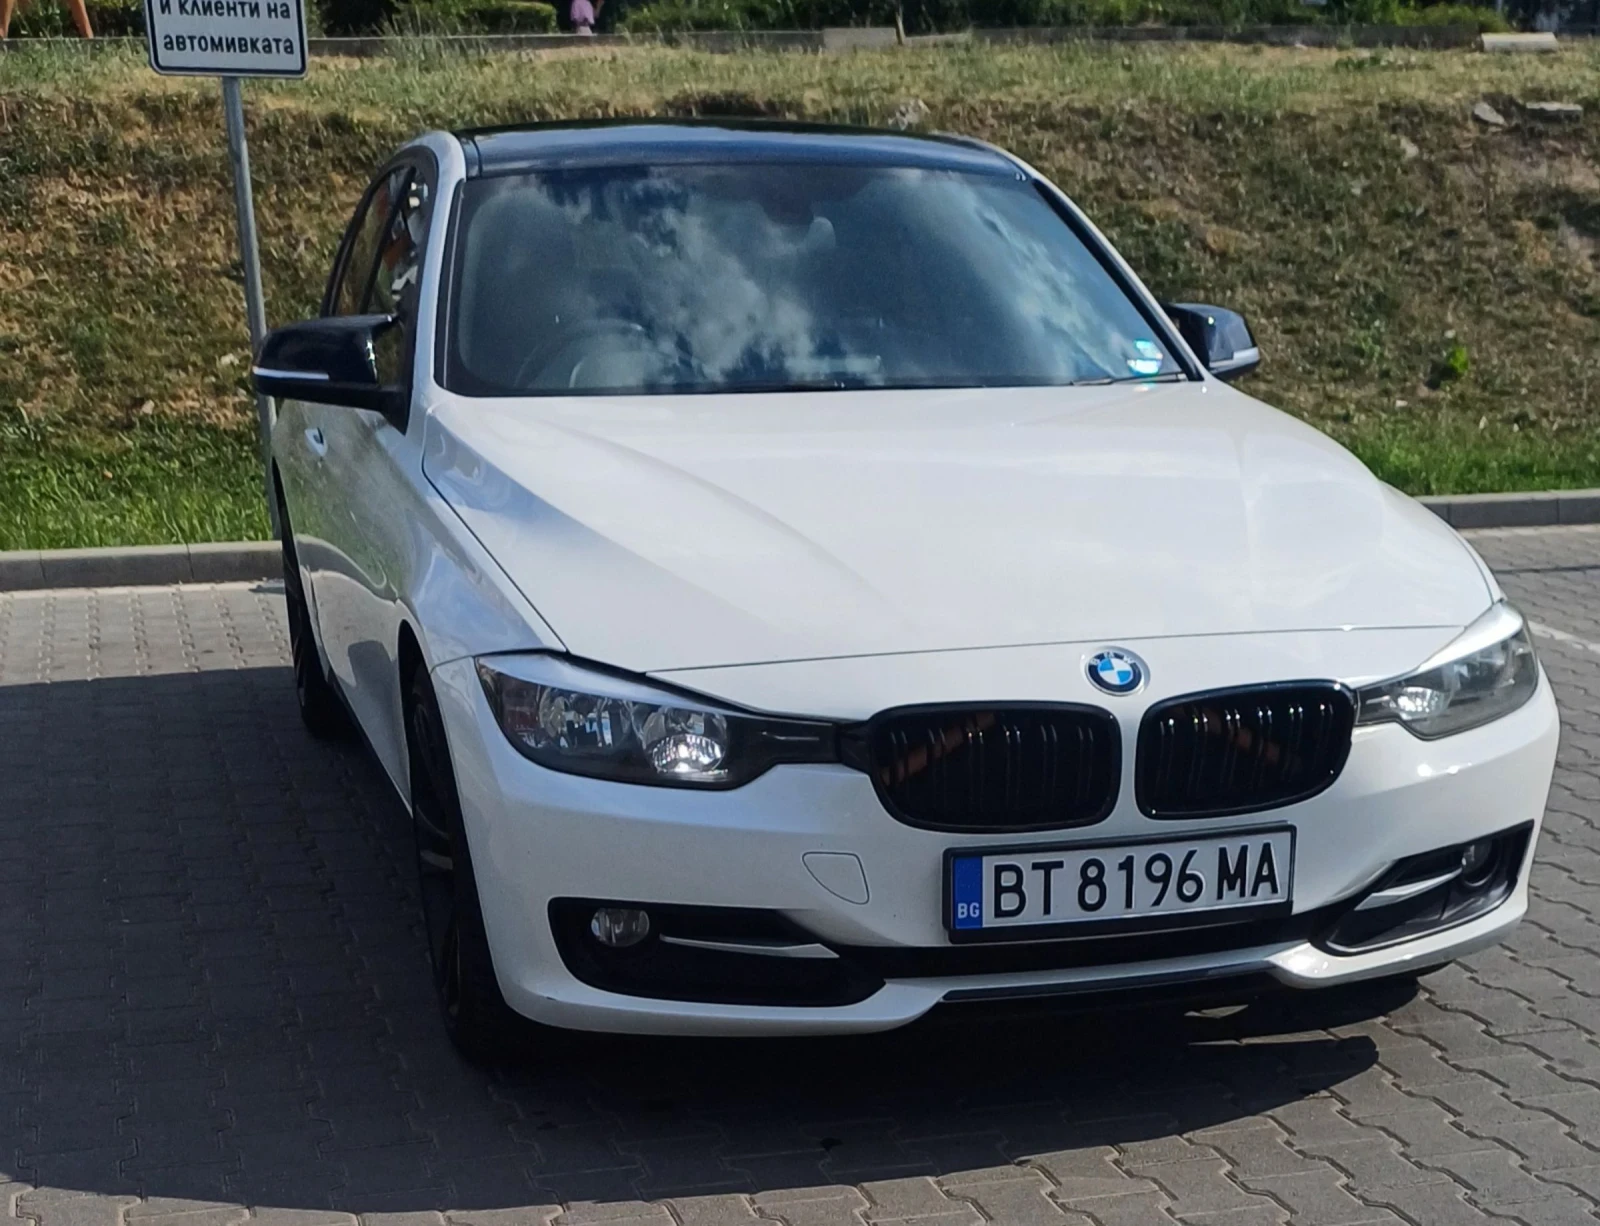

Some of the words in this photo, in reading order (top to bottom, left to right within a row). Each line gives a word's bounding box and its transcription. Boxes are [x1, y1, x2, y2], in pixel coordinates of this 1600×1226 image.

[159, 0, 171, 15] и
[178, 0, 260, 19] клиенти
[267, 2, 291, 19] на
[163, 34, 294, 55] автомивката
[993, 860, 1064, 919] BT
[1077, 849, 1204, 912] 8196
[1216, 841, 1279, 901] MA
[957, 902, 980, 919] BG
